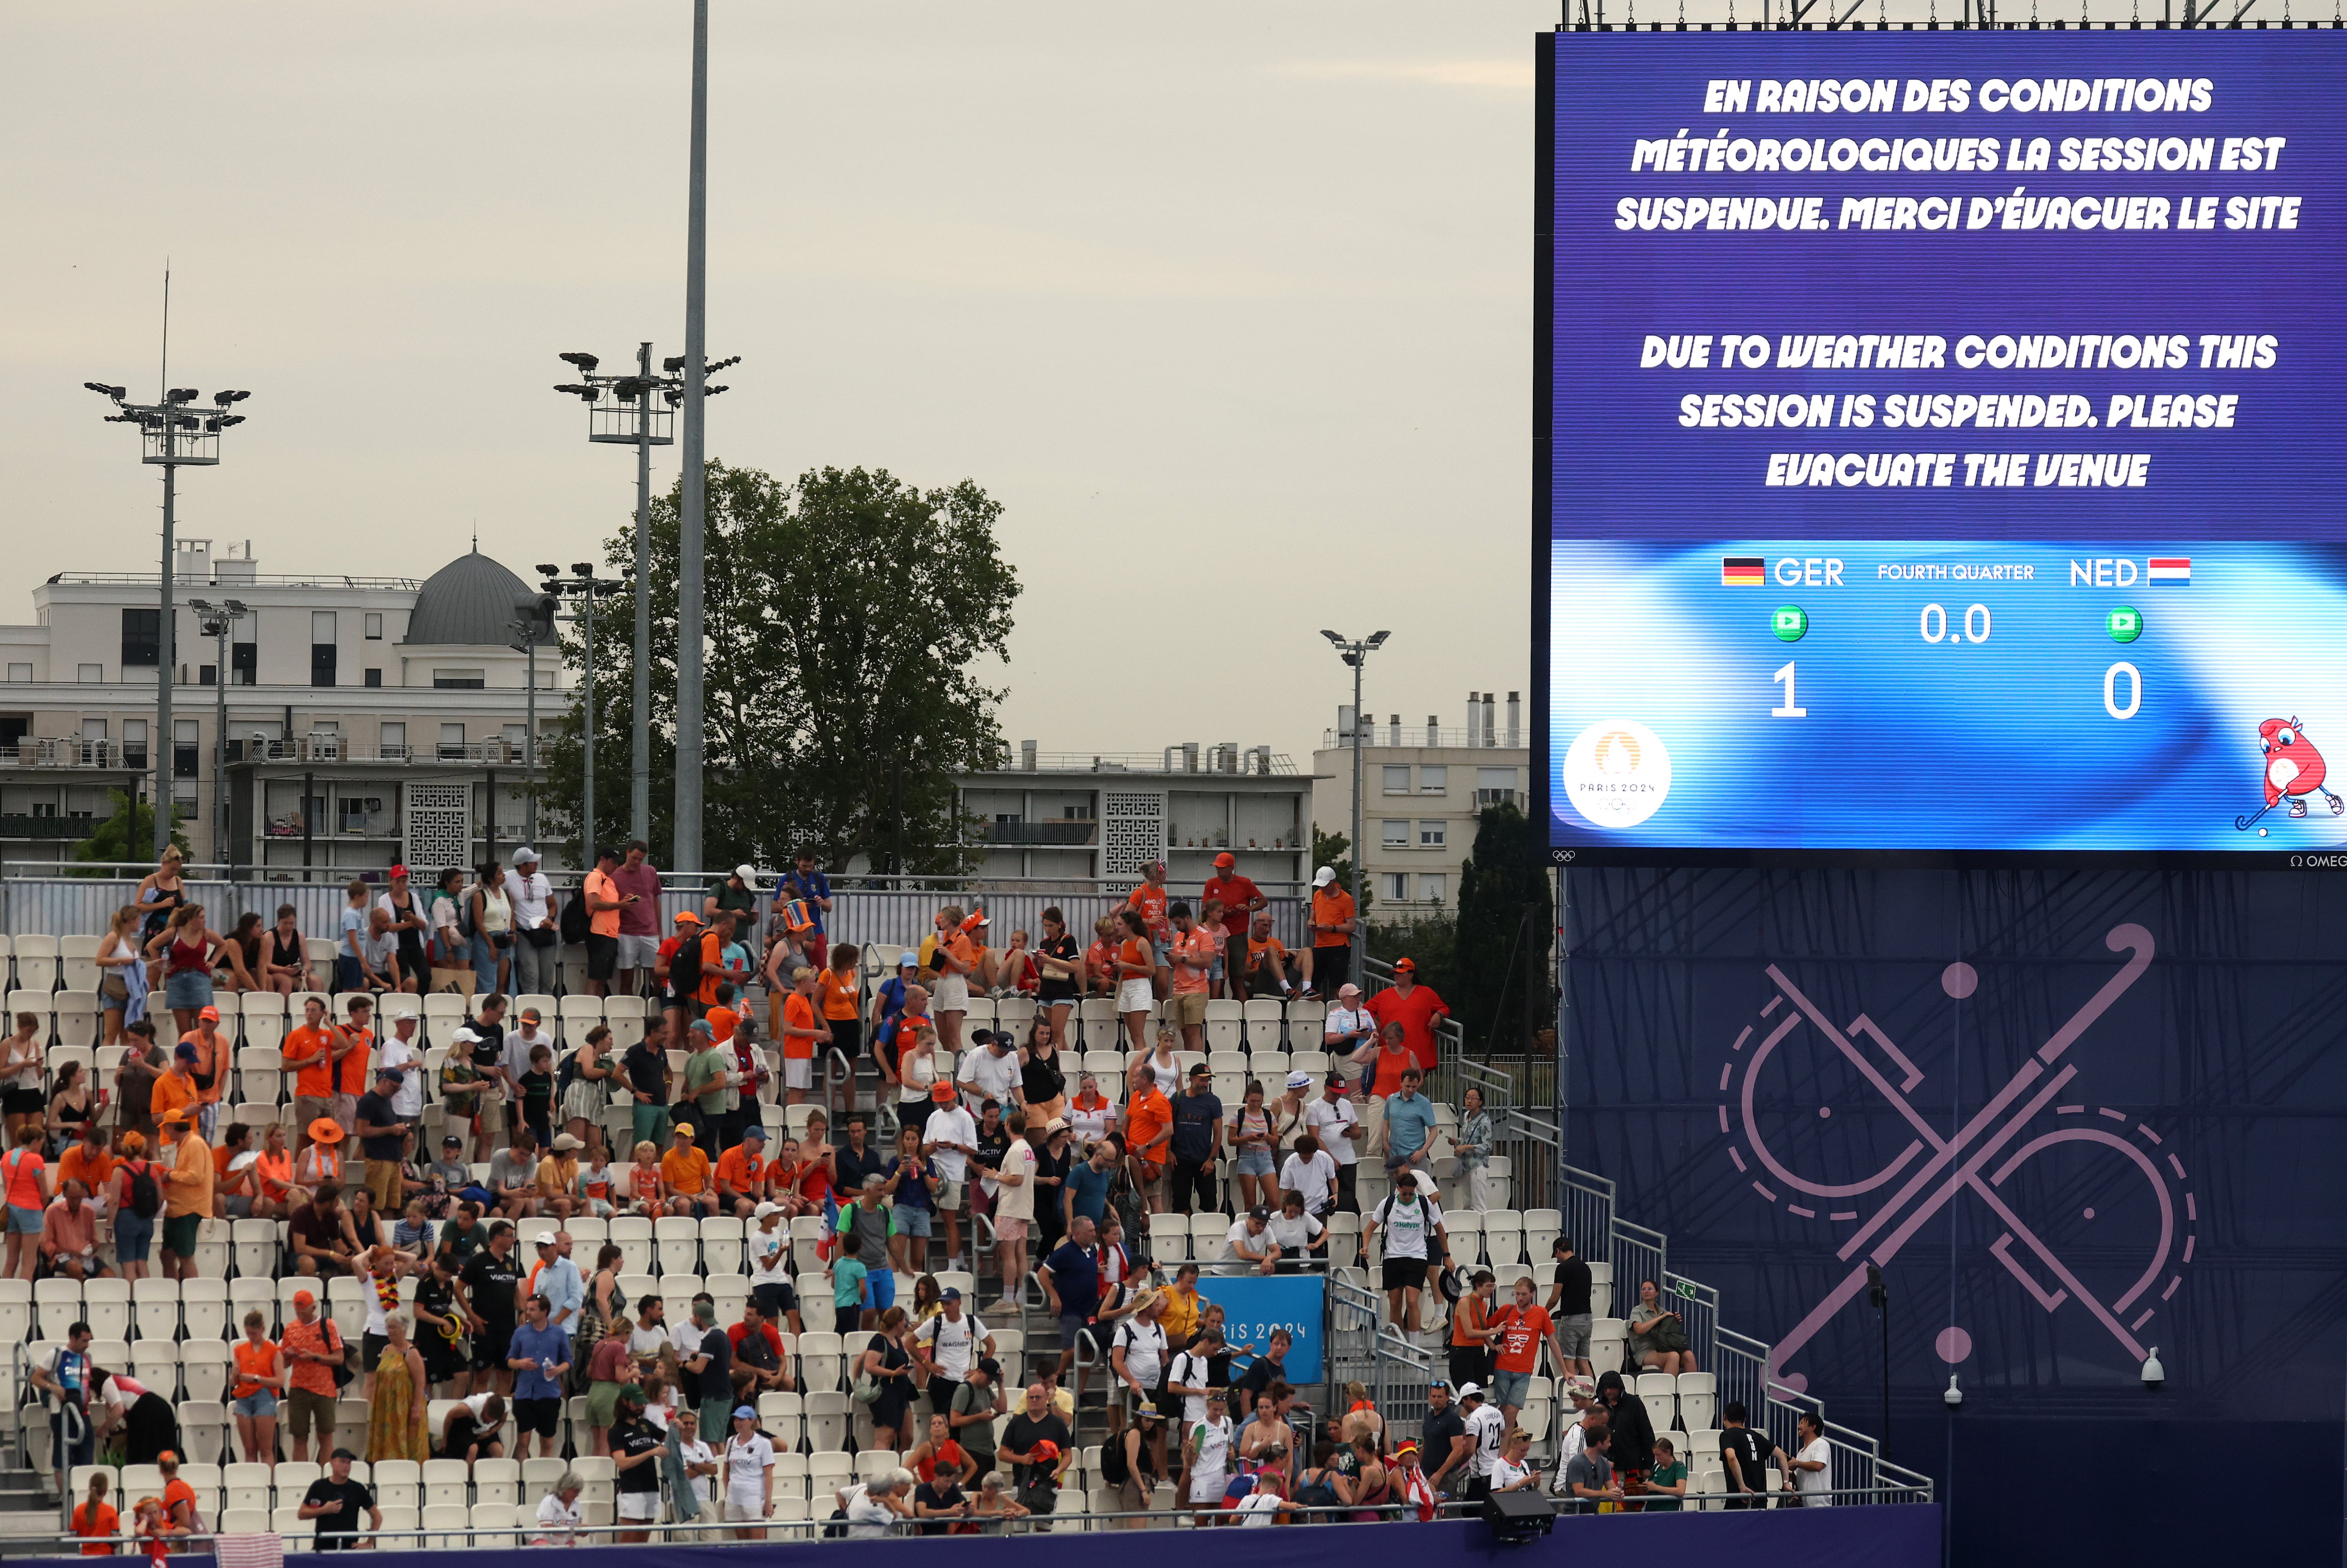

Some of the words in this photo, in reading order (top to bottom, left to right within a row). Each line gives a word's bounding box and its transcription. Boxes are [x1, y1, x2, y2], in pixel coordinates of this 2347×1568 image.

[1704, 80, 1751, 112] EN
[1756, 79, 1898, 112] RAISON
[1902, 79, 1971, 112] DES
[1979, 78, 2214, 112] CONDITIONS
[1631, 128, 2001, 171] MÉTÉOROLOGIQUES
[2006, 138, 2051, 170] LA
[2058, 137, 2215, 171] SESSION
[2219, 137, 2286, 170] EST
[1615, 197, 1829, 230] SUSPENDUE.
[1838, 197, 1962, 230] MERCI
[1966, 187, 2171, 230] D'ÉVACUER
[2177, 197, 2219, 229] LE
[2224, 197, 2302, 229] SITE
[1640, 335, 1713, 368] DUE
[1720, 335, 1771, 368] TO
[1777, 335, 1947, 368] WEATHER
[1955, 335, 2190, 368] CONDITIONS
[2199, 335, 2278, 368] THIS
[1679, 394, 1835, 427] SESSION
[1839, 394, 1876, 428] IS
[1883, 394, 2098, 428] SUSPENDED.
[2106, 394, 2239, 428] PLEASE
[1765, 453, 1956, 487] EVACUATE
[1964, 453, 2030, 486] THE
[2034, 454, 2151, 487] VENUE
[1775, 558, 1844, 586] GER
[1878, 565, 1948, 579] FOURTH
[1952, 565, 2034, 580] QUARTER
[2071, 558, 2139, 586] NED
[1921, 604, 1991, 643] 0.0
[1772, 661, 1807, 717] 1
[2104, 662, 2142, 719] 0
[1488, 1420, 1500, 1450] 21
[1746, 1433, 1757, 1461] RUN
